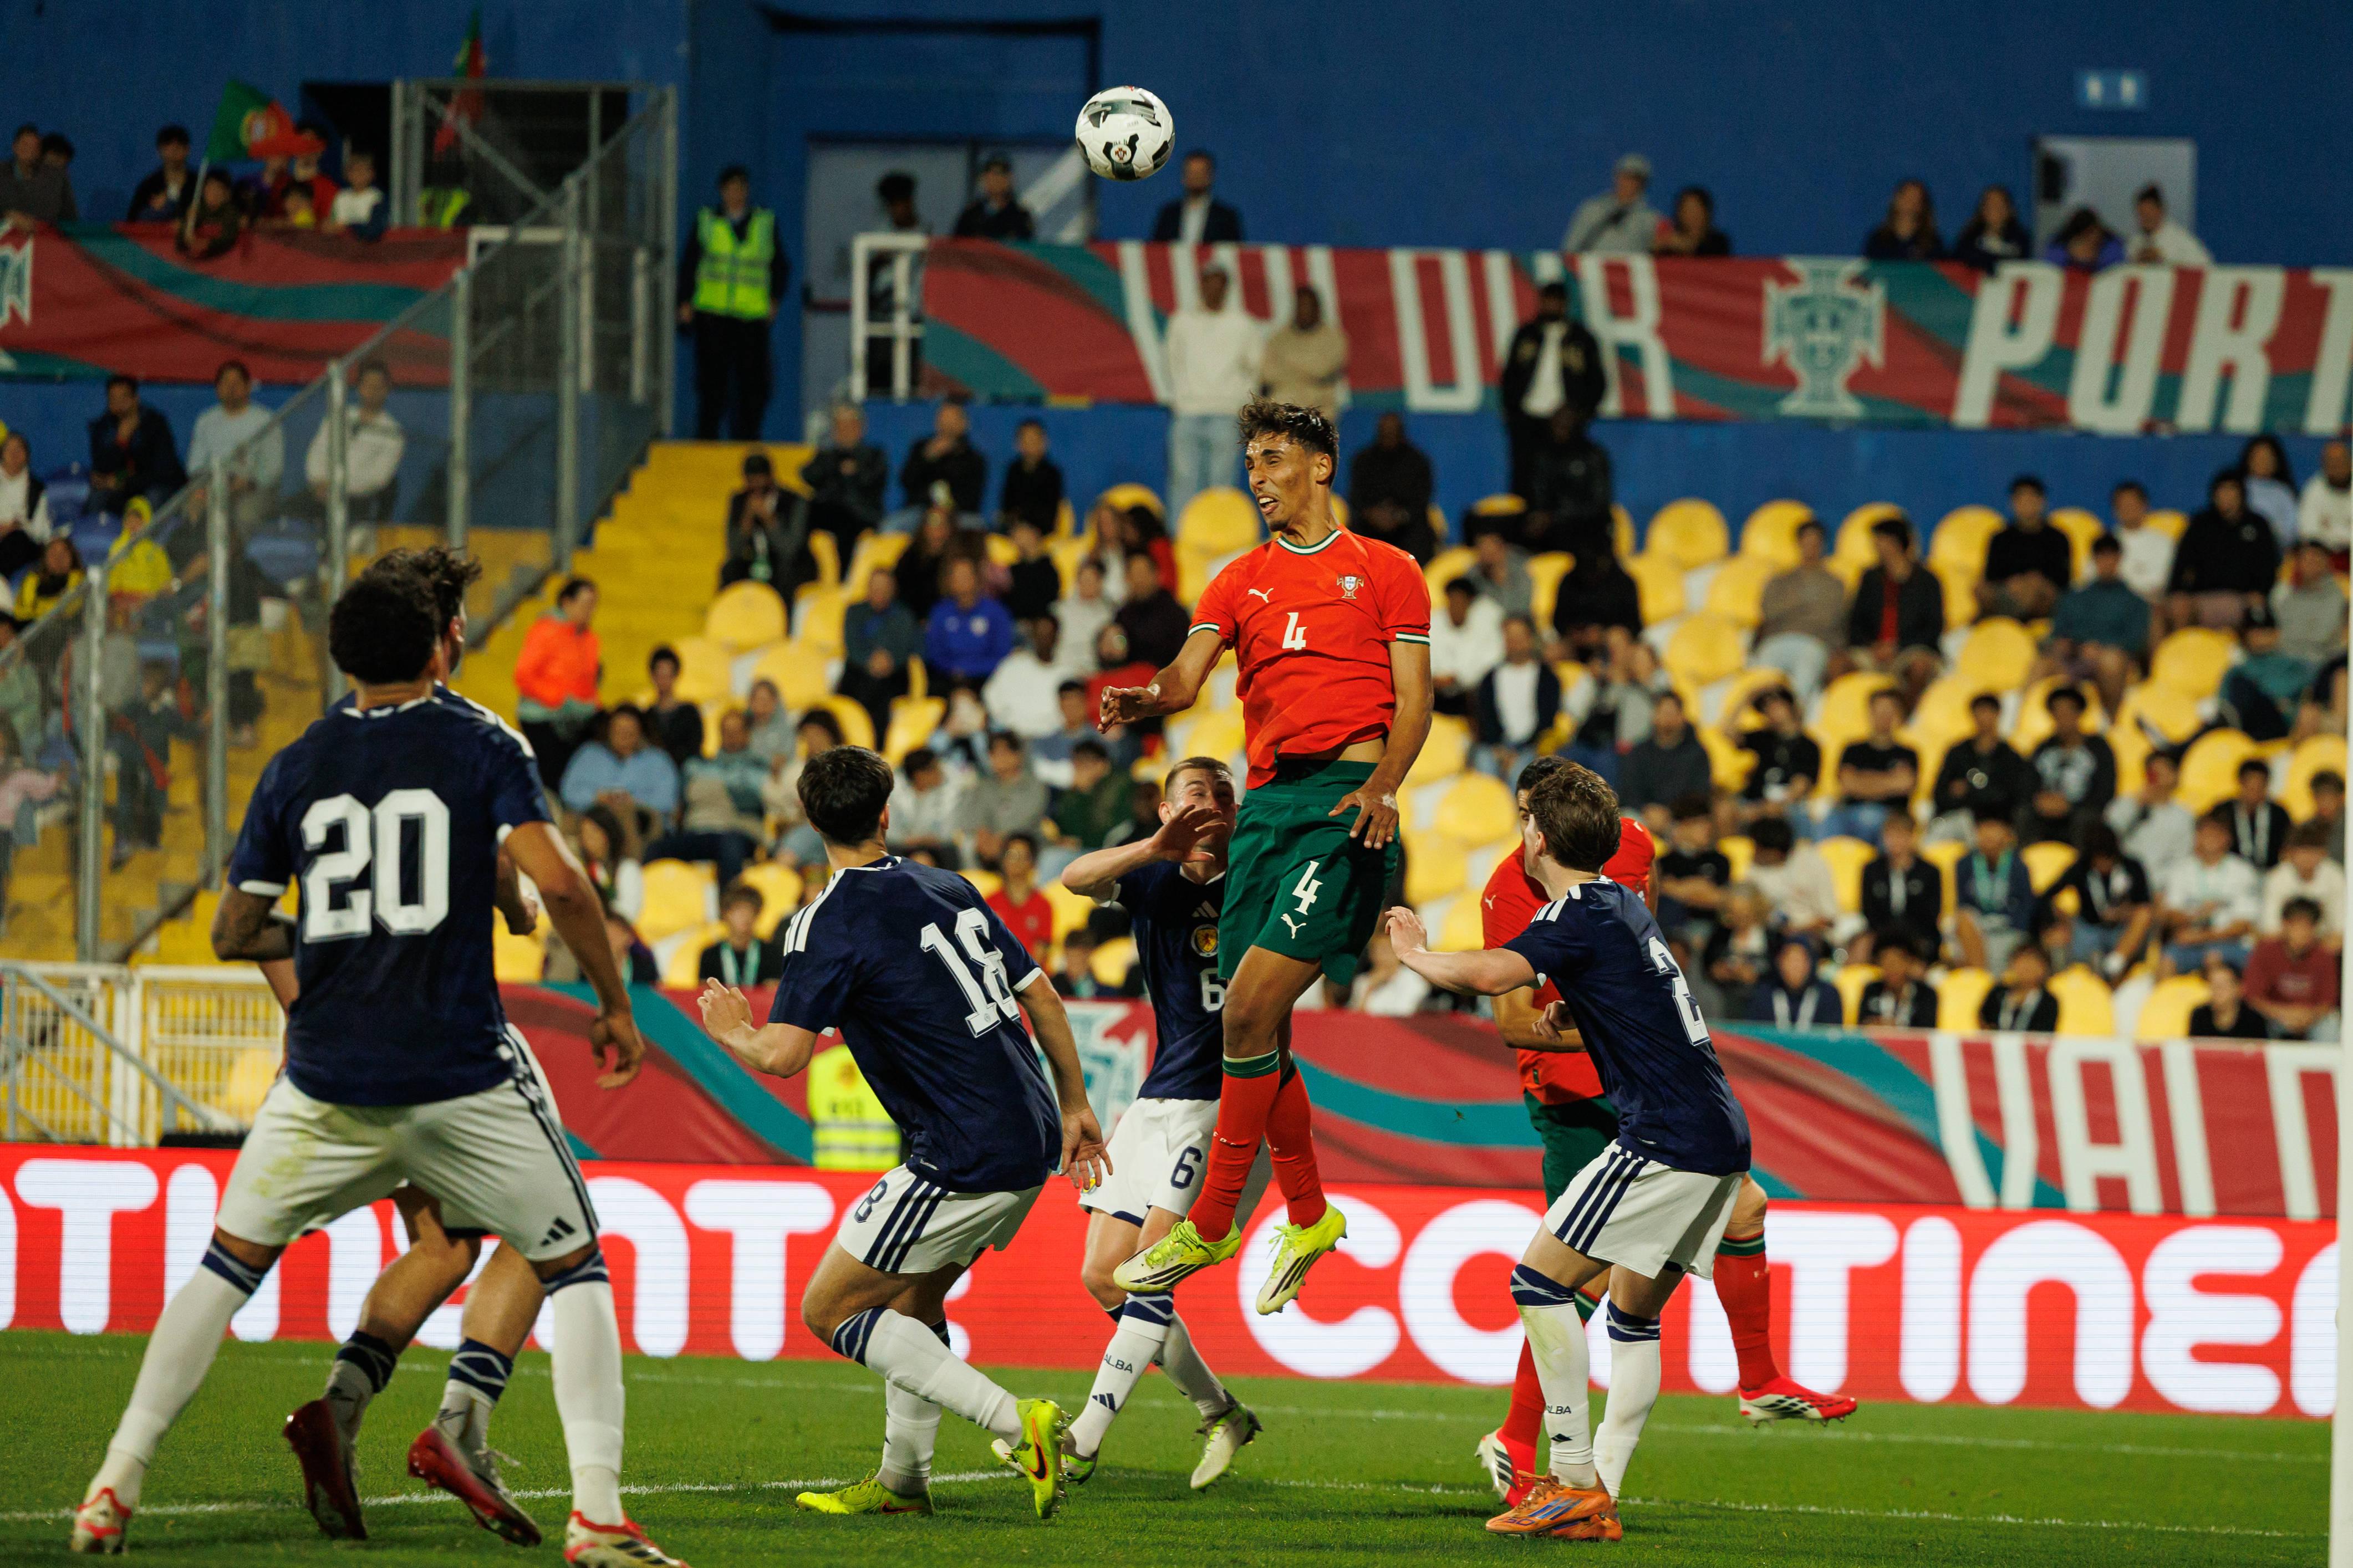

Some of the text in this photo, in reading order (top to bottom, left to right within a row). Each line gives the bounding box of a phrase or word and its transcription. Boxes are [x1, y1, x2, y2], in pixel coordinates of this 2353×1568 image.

[1282, 612, 1307, 650] 4
[300, 788, 450, 943] 20
[1292, 860, 1323, 916] 4
[920, 907, 1020, 1038] 18
[1200, 968, 1226, 1013] 6
[1648, 936, 1712, 1046] 2
[1928, 1031, 2218, 1218] VAI
[1171, 1146, 1203, 1189] 6
[854, 1179, 888, 1223] 8
